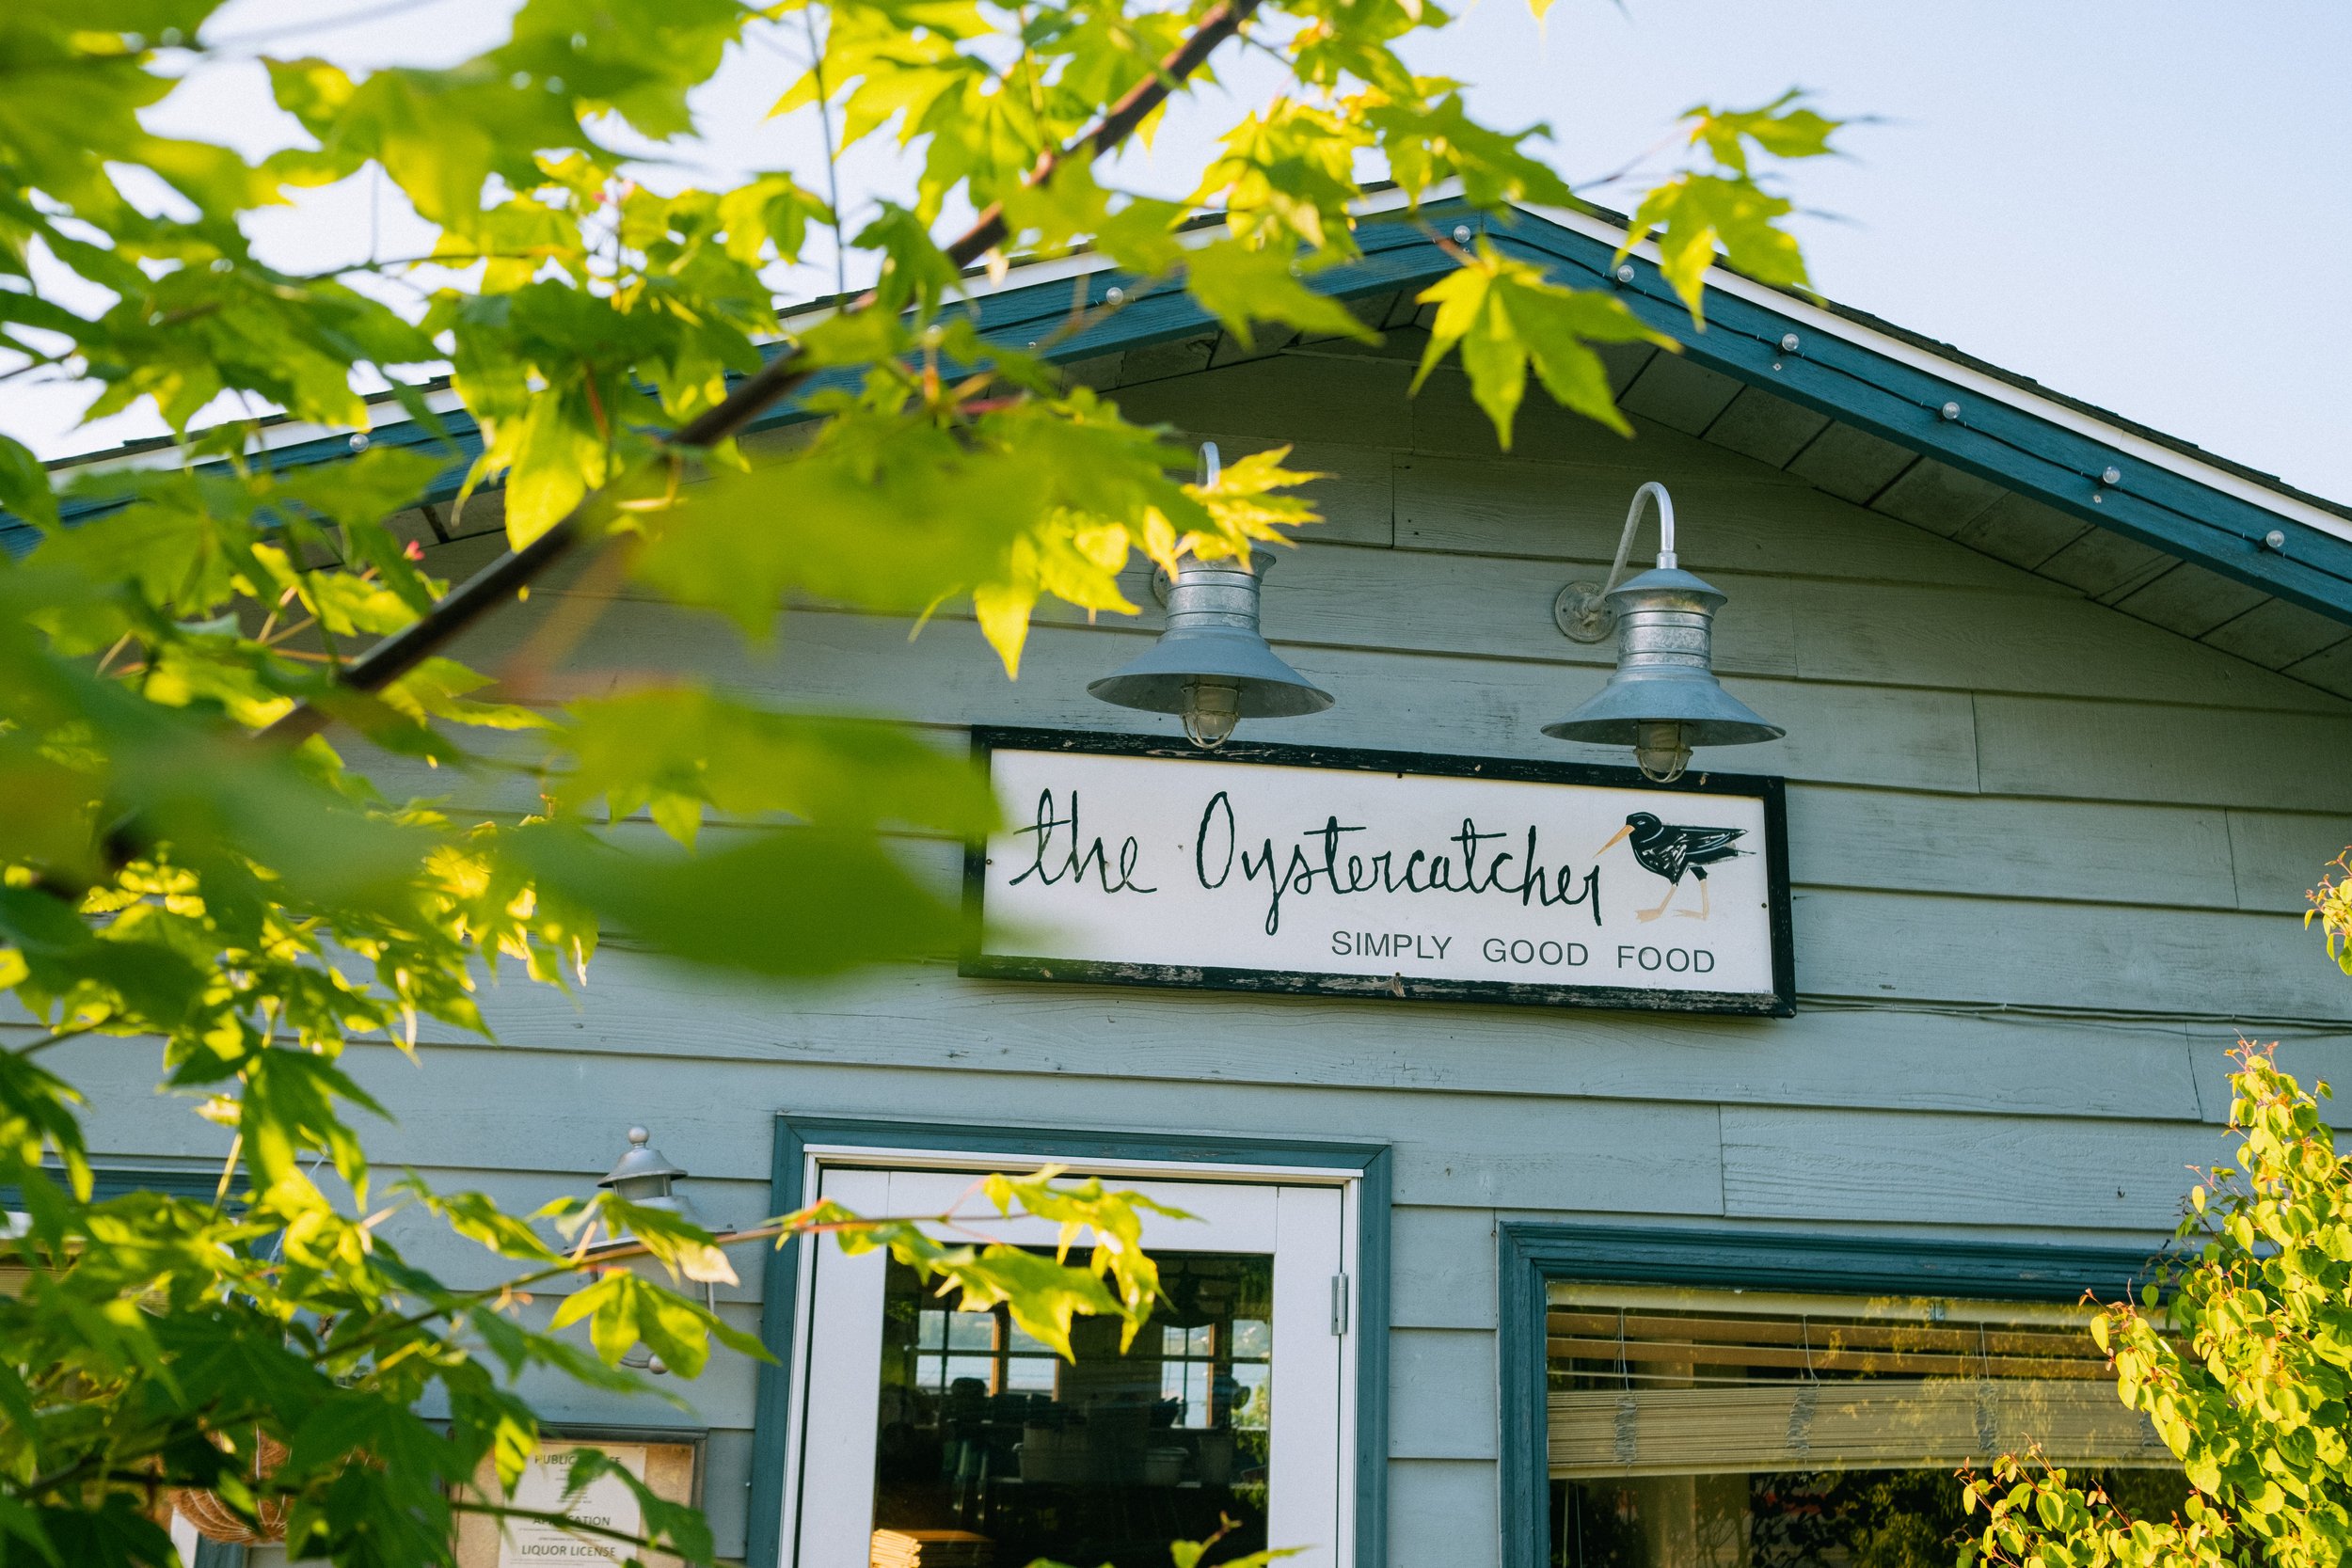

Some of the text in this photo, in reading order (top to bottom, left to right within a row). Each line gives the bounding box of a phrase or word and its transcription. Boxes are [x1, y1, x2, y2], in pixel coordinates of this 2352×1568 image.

[1009, 787, 1603, 936] the Oystercatcher
[1331, 930, 1715, 974] SIMPLY GOOD FOOD
[521, 1544, 616, 1558] LIQUOR LICENSE
